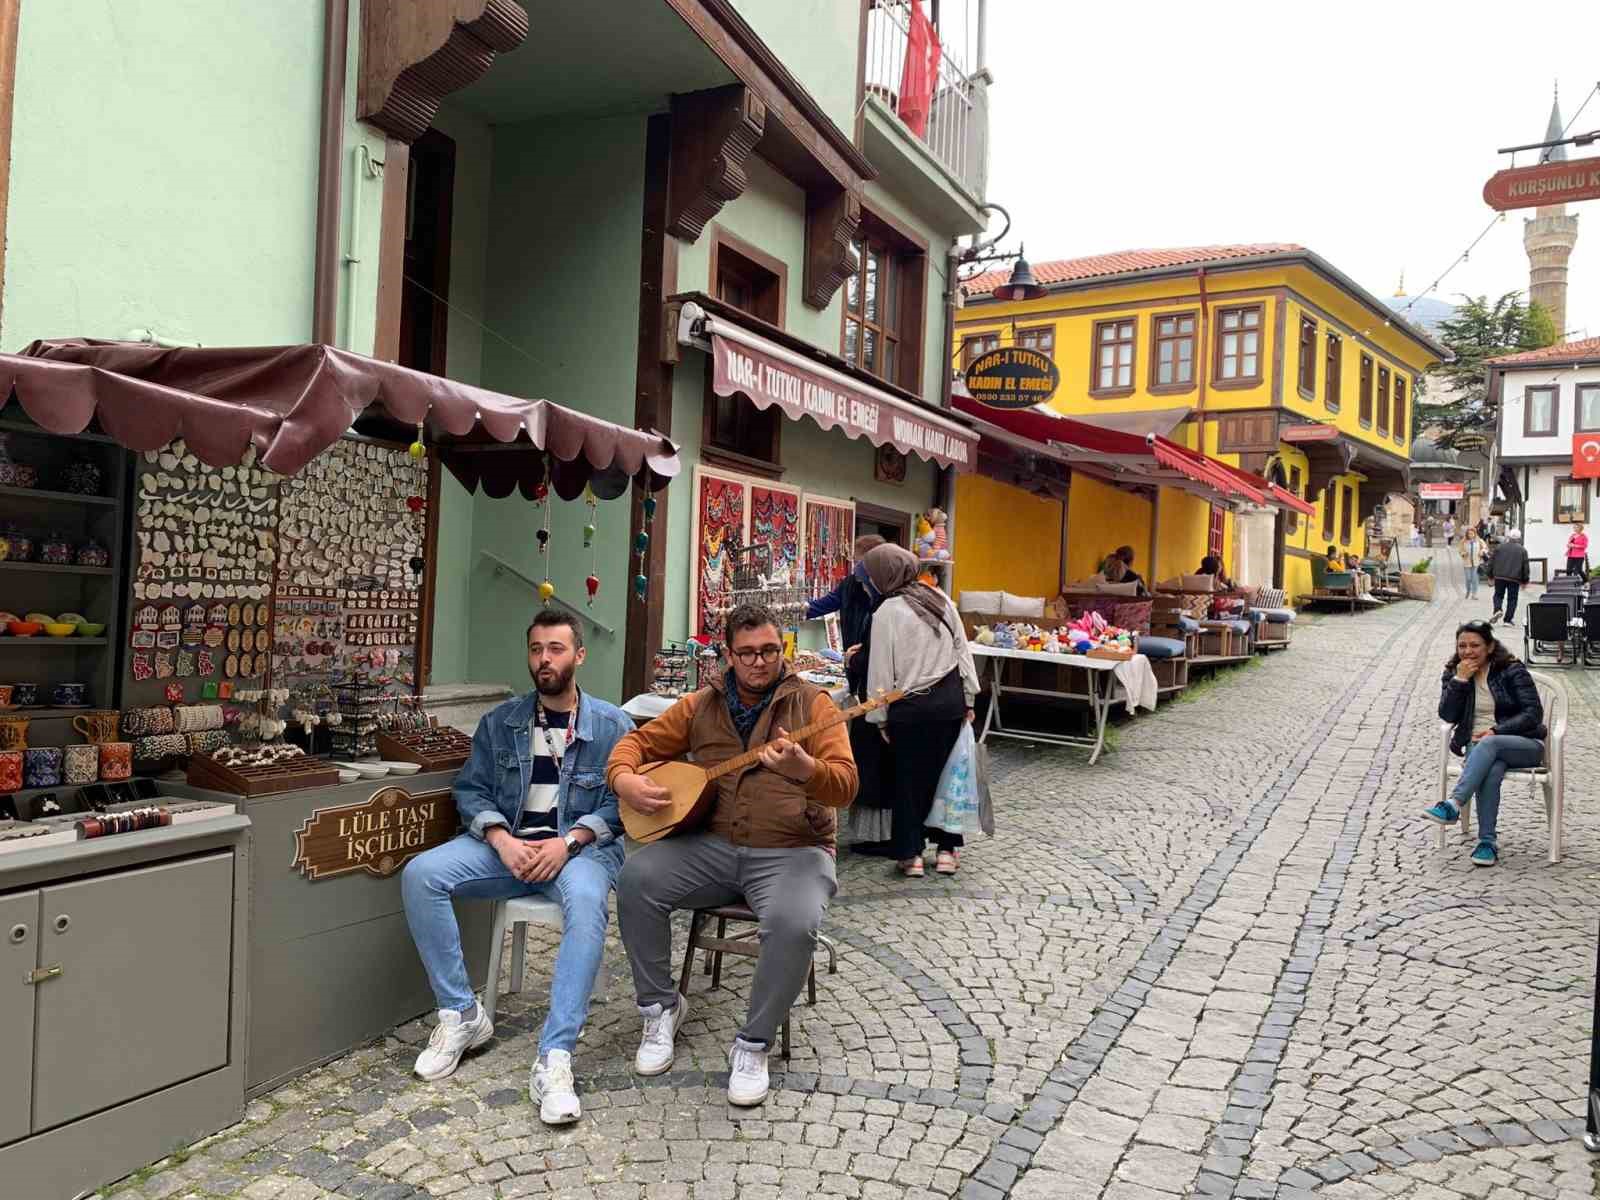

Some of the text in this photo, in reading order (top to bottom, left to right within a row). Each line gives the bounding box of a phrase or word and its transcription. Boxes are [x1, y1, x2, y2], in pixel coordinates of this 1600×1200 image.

[1508, 172, 1585, 196] KURŞUNLU
[976, 351, 1049, 374] NAR-I TUTKU
[968, 376, 1002, 390] KADIN
[1005, 377, 1016, 390] EL
[727, 351, 968, 464] NAR-I TUTKU KADIN EL EMEĞİ WOMAN HAND LABOR
[339, 802, 435, 836] LÜLE TAŞI
[347, 821, 424, 863] İŞÇİLİĞİ
